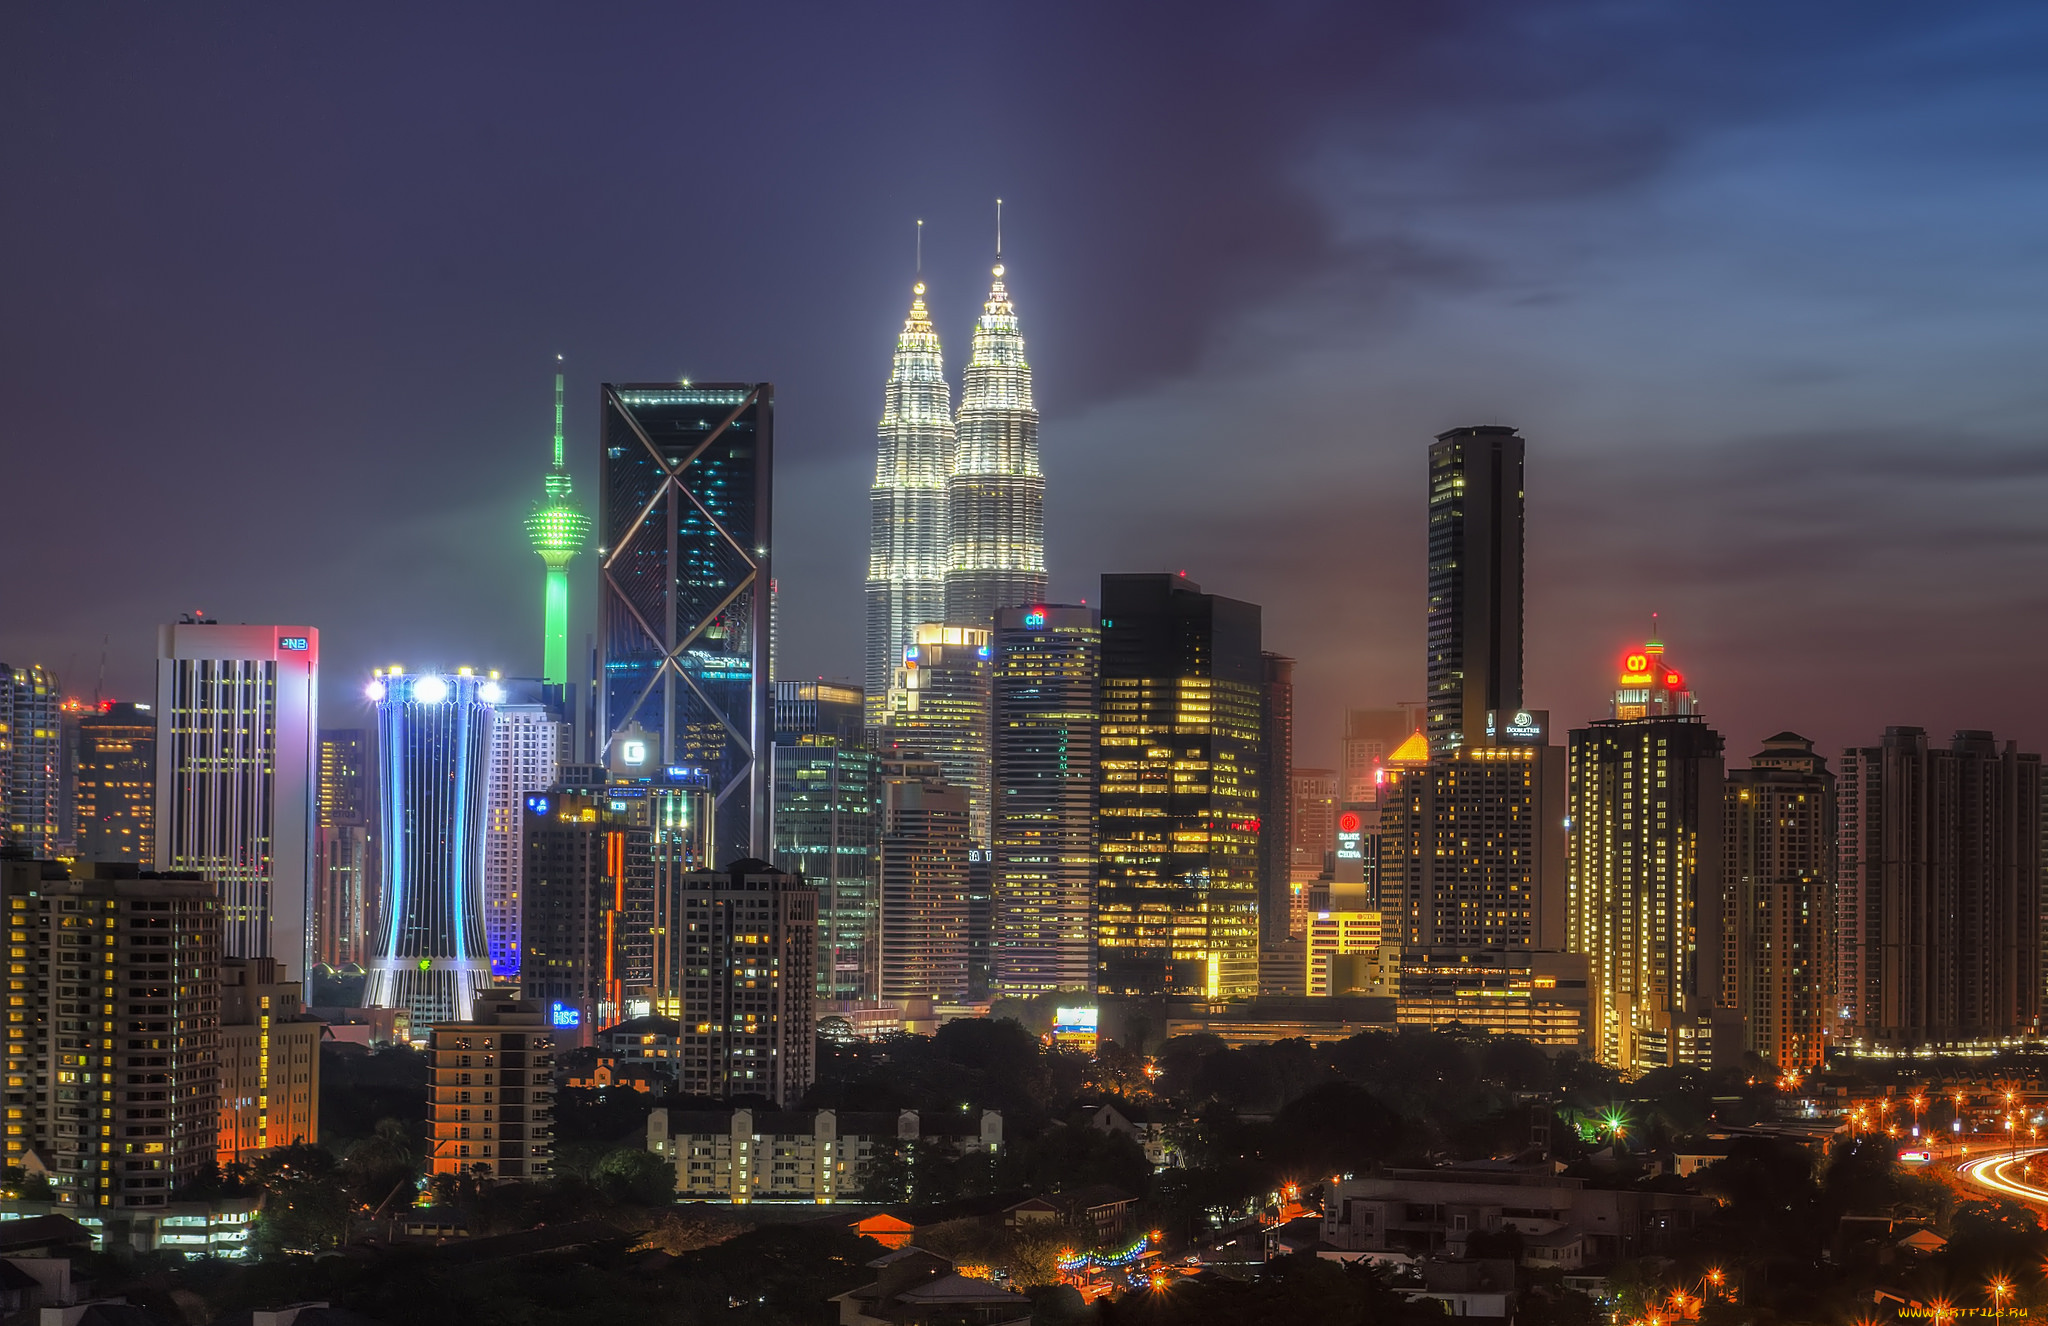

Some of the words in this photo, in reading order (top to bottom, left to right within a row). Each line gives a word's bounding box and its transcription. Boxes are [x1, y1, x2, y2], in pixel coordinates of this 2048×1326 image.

[1025, 614, 1043, 625] citi
[281, 638, 306, 649] PNB
[553, 1011, 579, 1025] HSC
